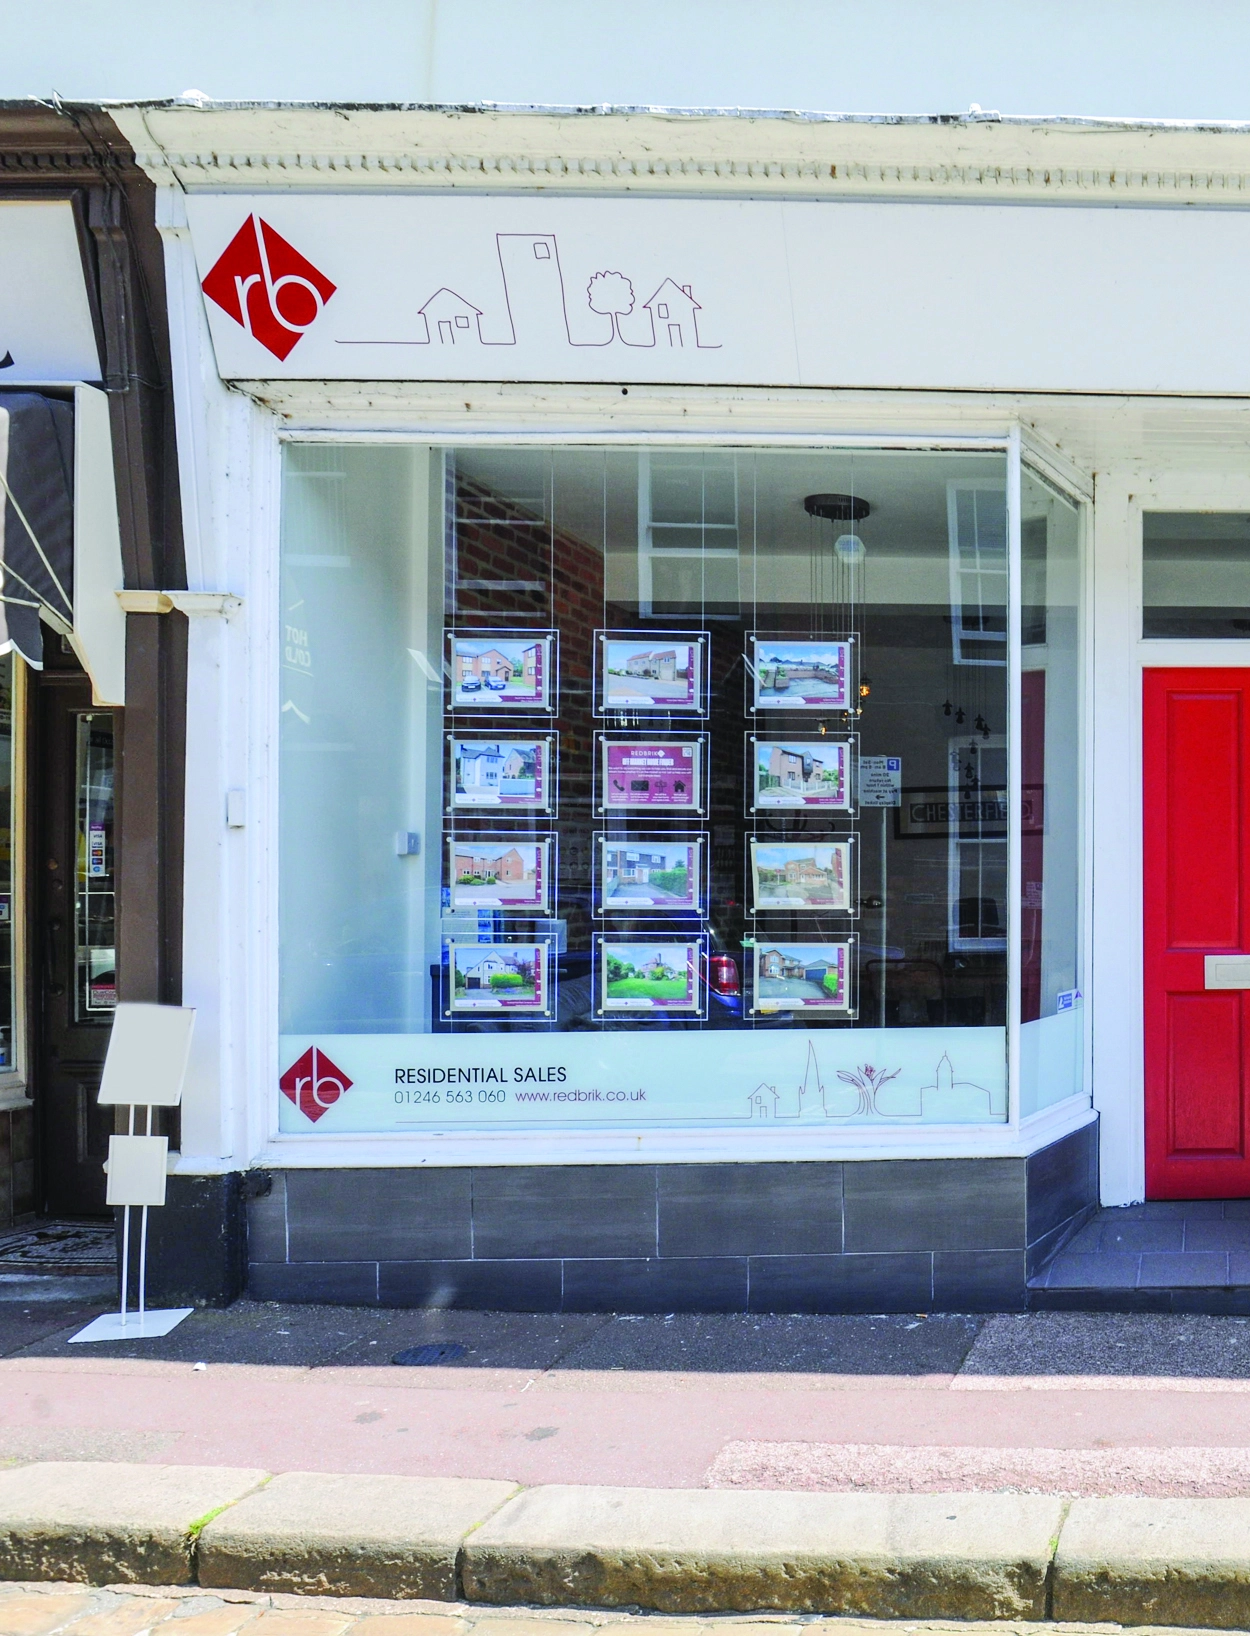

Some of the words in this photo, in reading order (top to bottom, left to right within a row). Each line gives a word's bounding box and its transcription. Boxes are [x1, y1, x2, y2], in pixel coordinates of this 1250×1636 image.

[911, 803, 1031, 822] CHESTERFIED
[394, 1067, 508, 1084] RESIDENTIAL
[513, 1066, 567, 1083] SALES
[394, 1090, 441, 1104] 01246
[445, 1090, 474, 1104] 563
[478, 1089, 506, 1103] 060
[514, 1088, 647, 1102] www.redbrik.co.uk
